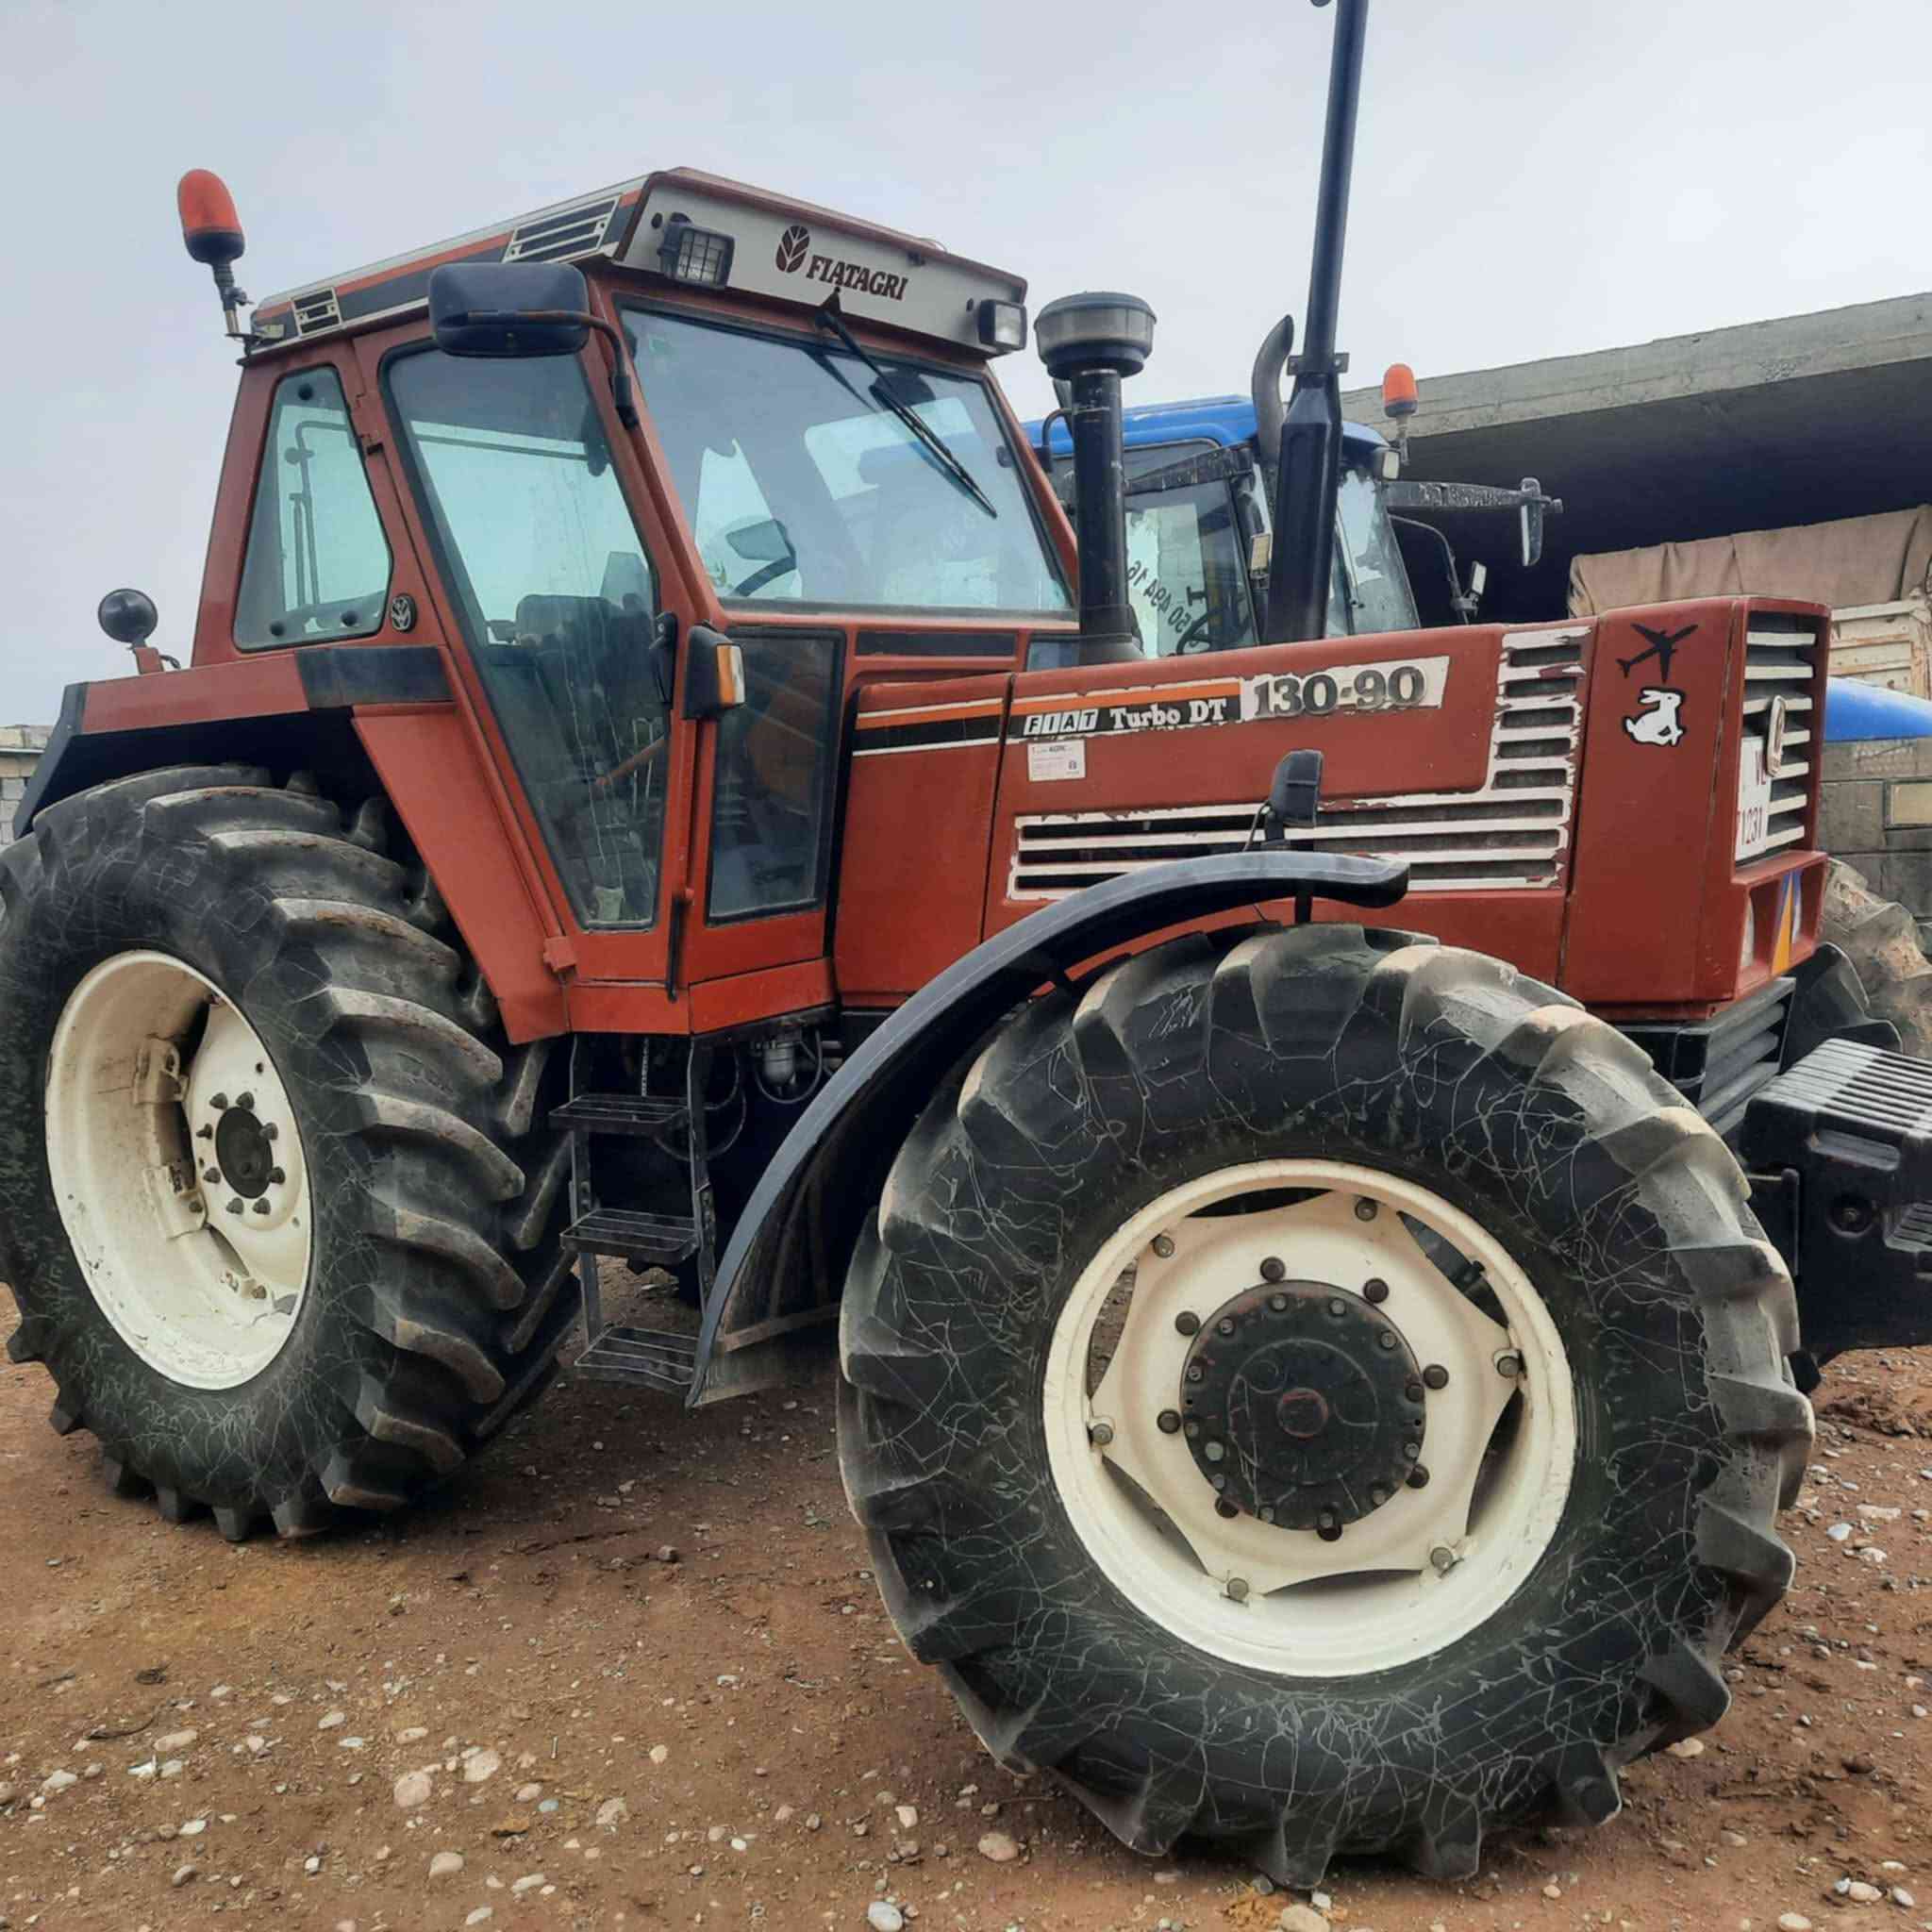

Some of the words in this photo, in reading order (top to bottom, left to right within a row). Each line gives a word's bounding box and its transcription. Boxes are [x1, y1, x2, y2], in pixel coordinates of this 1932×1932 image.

[806, 255, 908, 301] FIATAGRI
[1254, 666, 1426, 717] 130-90
[1023, 708, 1098, 736] FIAT
[1109, 703, 1181, 730] Turbo
[1189, 697, 1226, 724] DT
